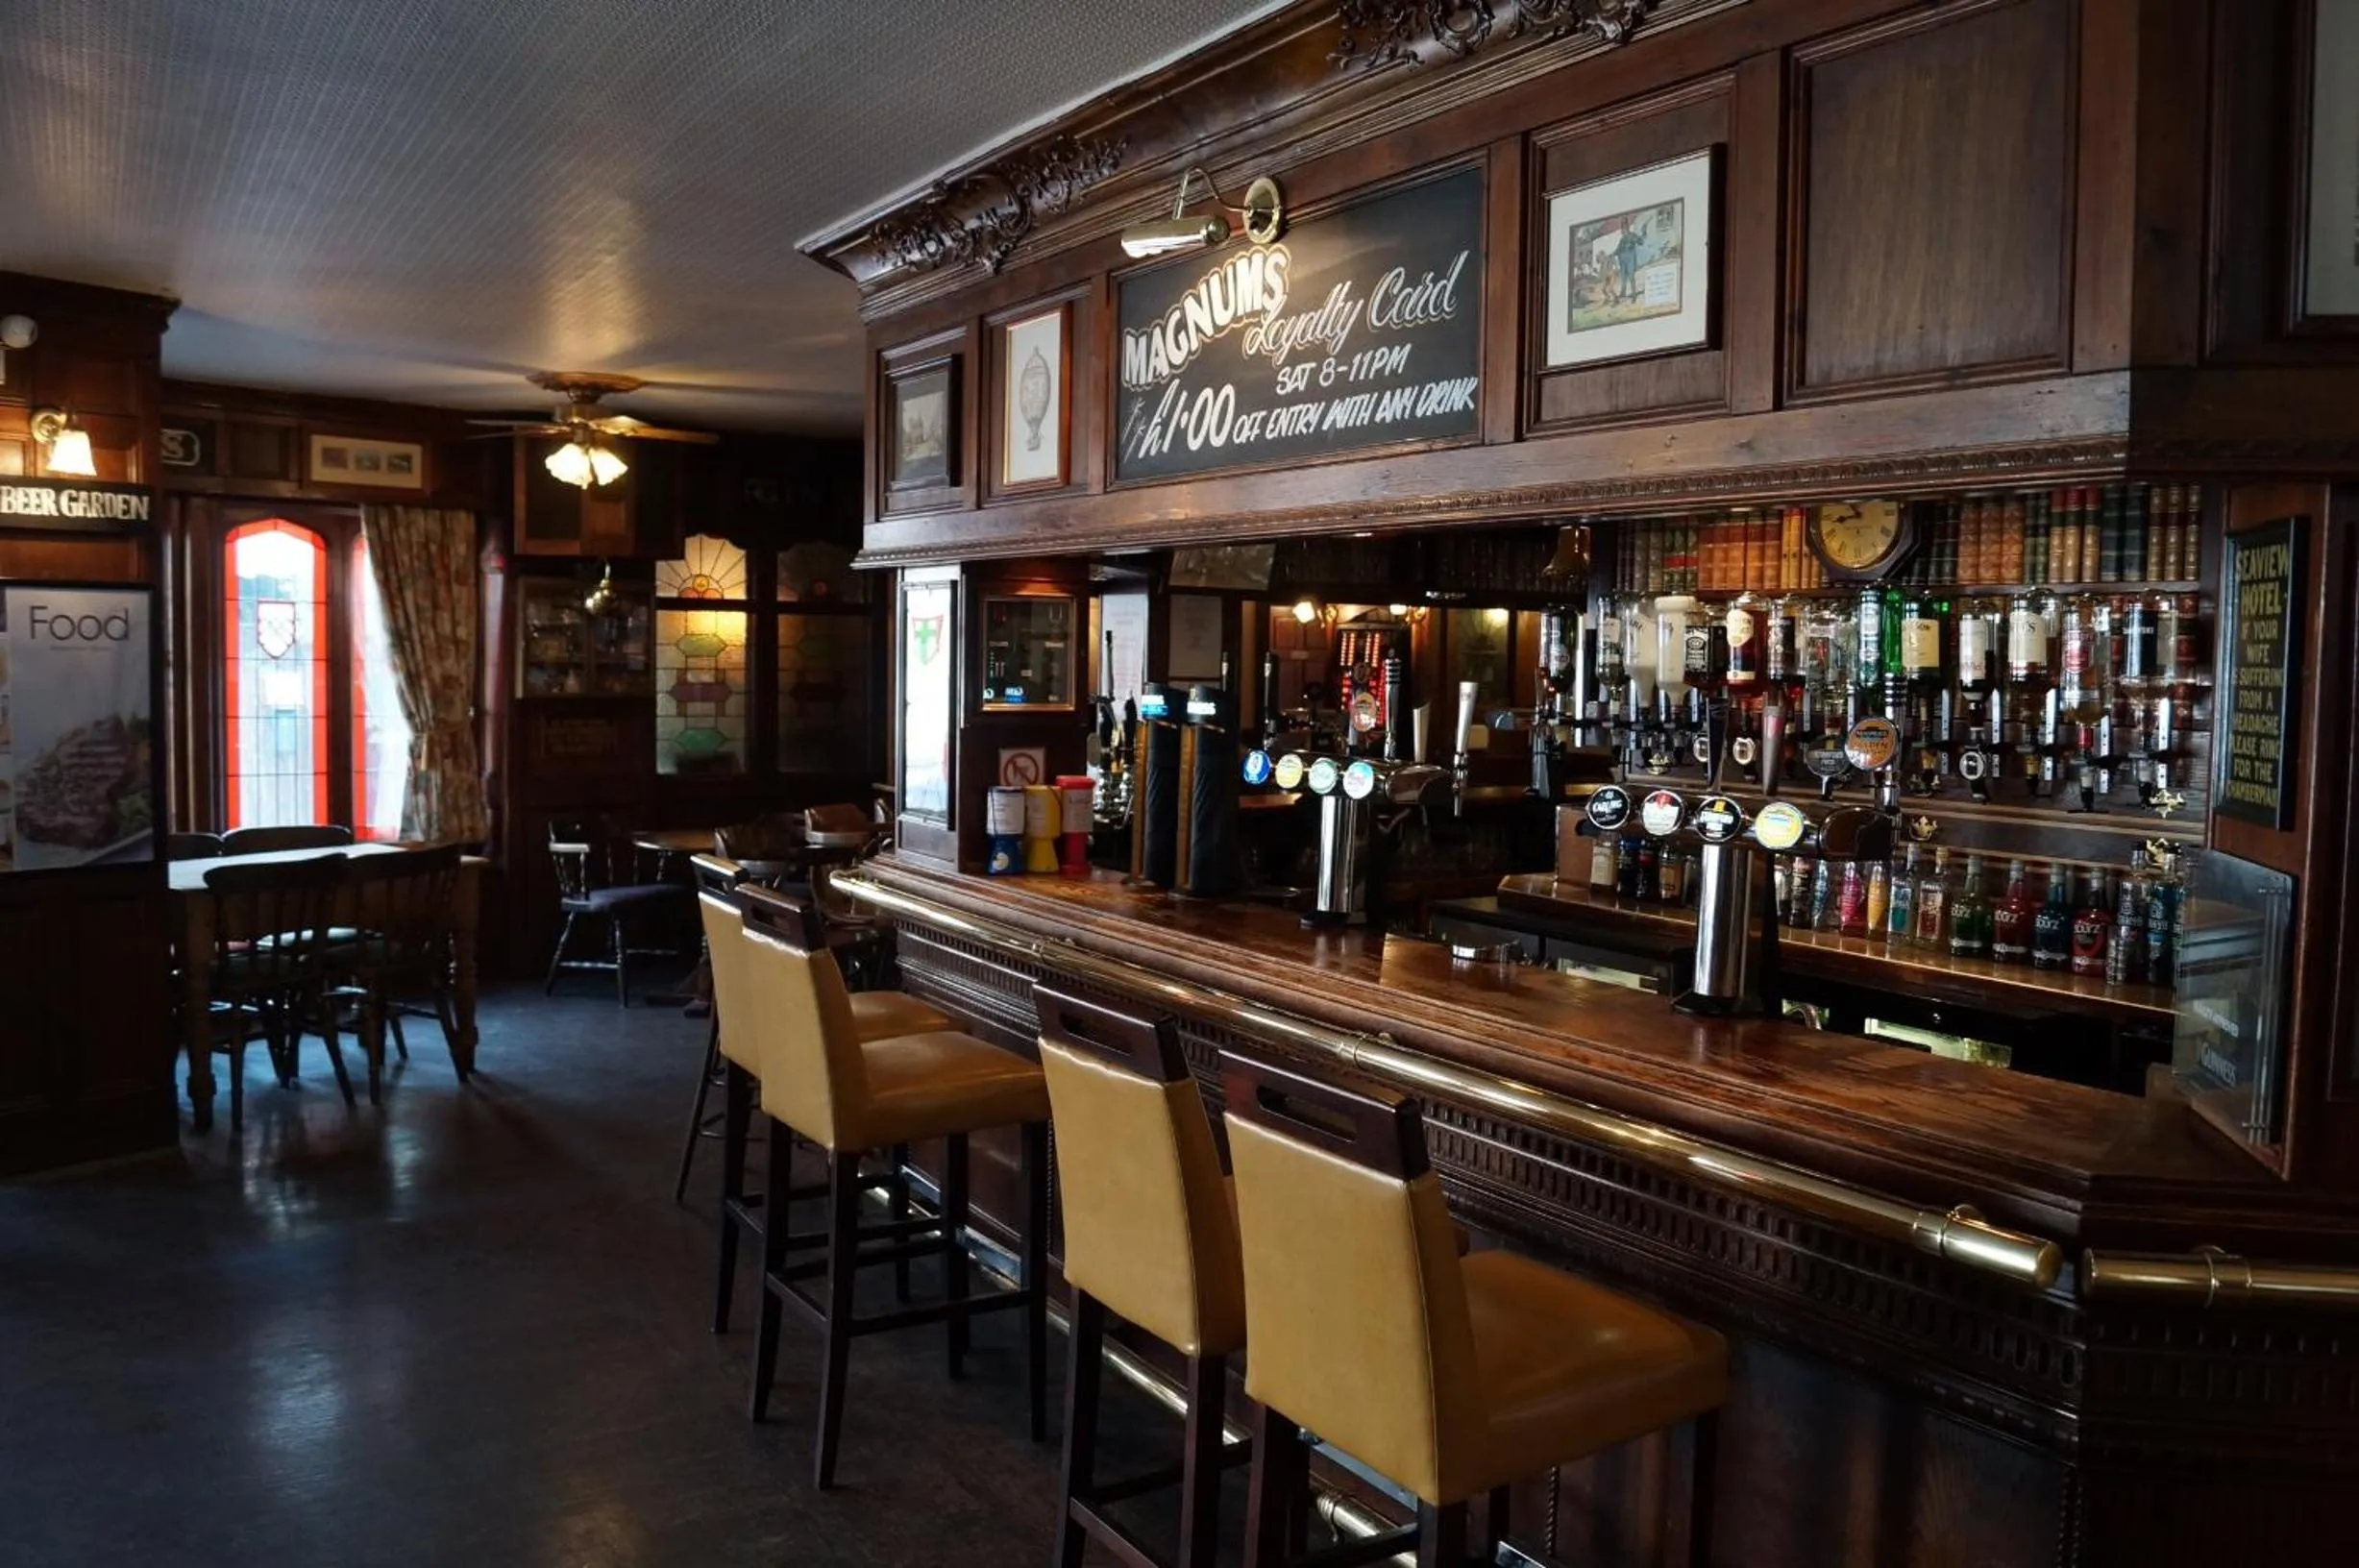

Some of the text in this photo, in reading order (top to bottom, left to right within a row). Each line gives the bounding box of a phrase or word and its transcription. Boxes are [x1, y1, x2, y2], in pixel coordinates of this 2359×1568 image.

[1123, 249, 1289, 385] MAGNUMS
[1245, 250, 1469, 363] Loyalty Card
[1276, 343, 1412, 396] SAT 8-11PM
[1233, 410, 1267, 445] OFF
[1266, 402, 1324, 441] ENTRY
[1322, 393, 1378, 432] WITH
[1374, 385, 1414, 425] ANY
[1414, 376, 1479, 419] DRINK
[0, 485, 151, 521] BEER GARDEN
[2235, 543, 2288, 581] SEAVIEW
[2241, 580, 2281, 617] HOTEL
[30, 604, 129, 641] Food
[2252, 619, 2278, 641] YOUR
[2247, 643, 2270, 665] WIFE
[2238, 689, 2274, 712] FROM A
[2234, 757, 2274, 784] FOR THE
